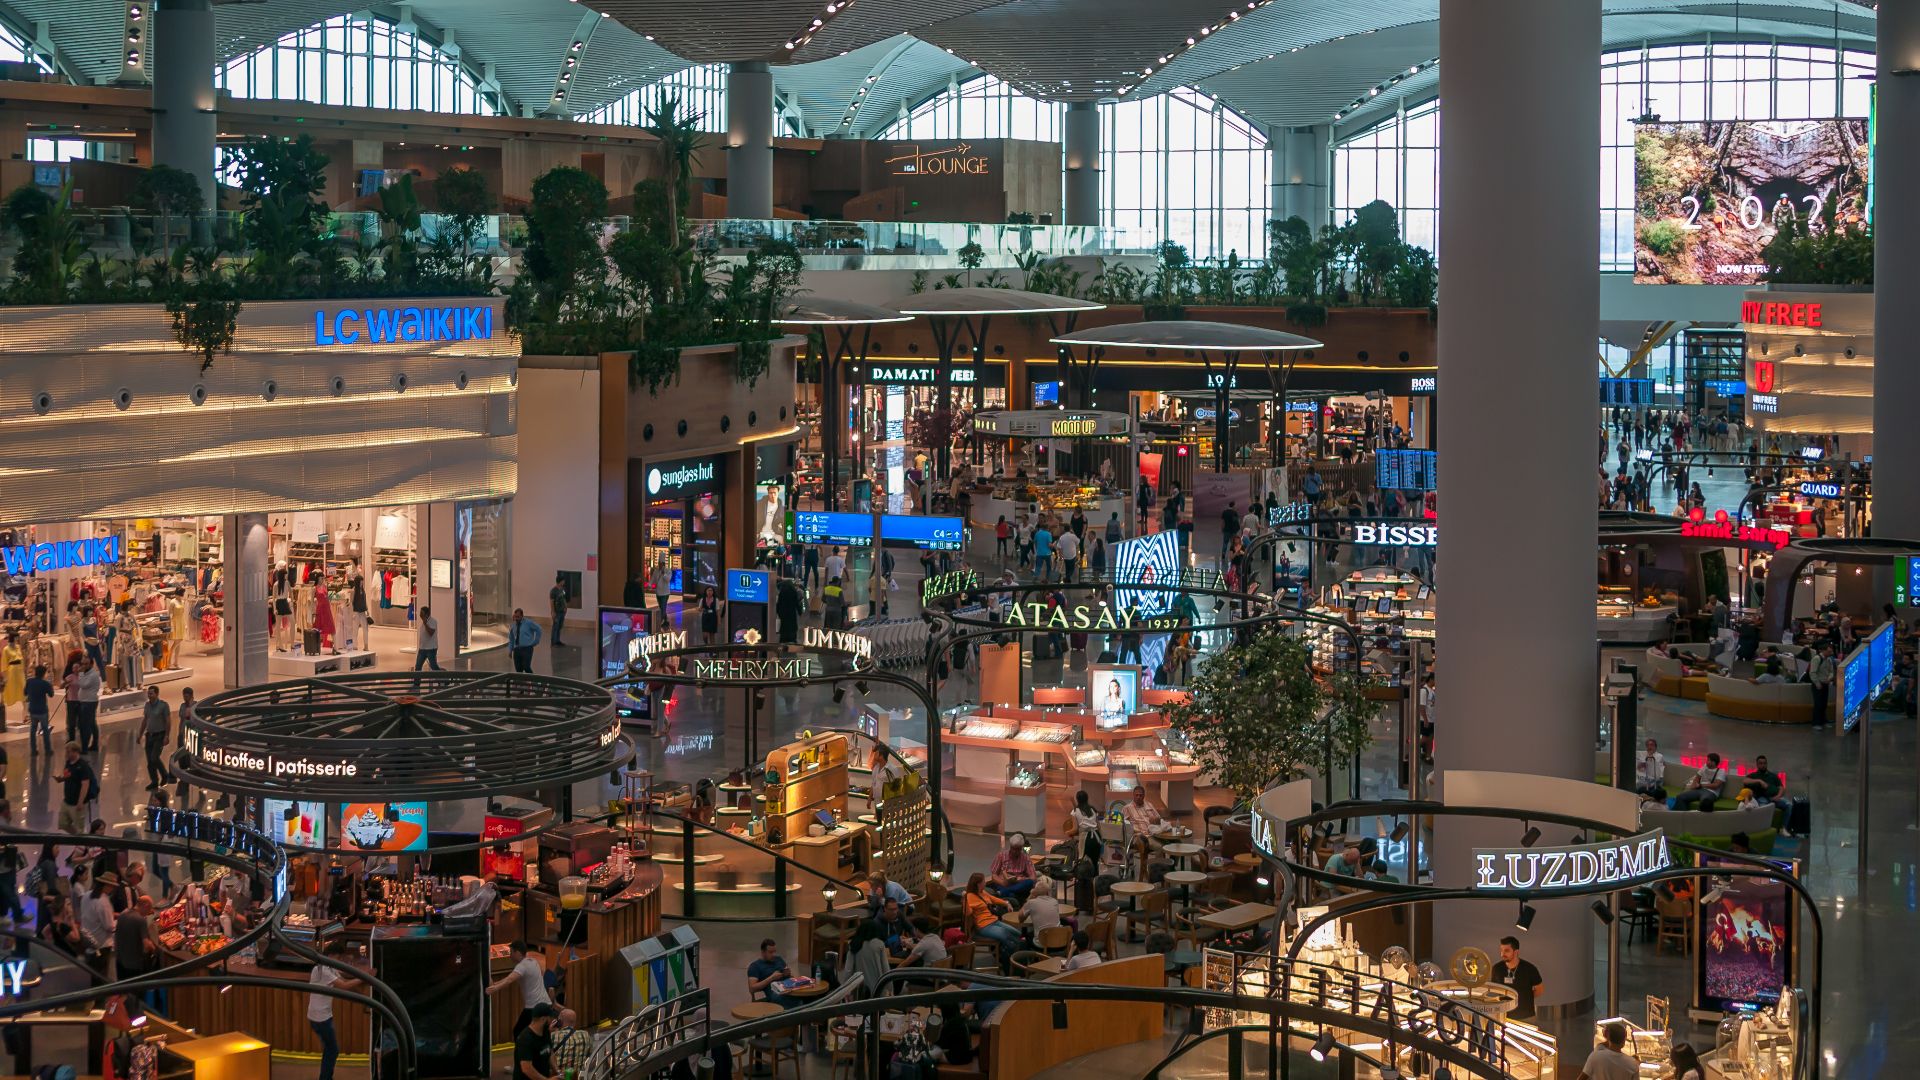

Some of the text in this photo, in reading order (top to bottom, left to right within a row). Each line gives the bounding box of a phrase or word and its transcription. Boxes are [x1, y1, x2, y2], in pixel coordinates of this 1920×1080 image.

[920, 157, 989, 174] LOUNGE
[1716, 264, 1742, 273] NOW
[1766, 302, 1822, 326] FREE
[315, 309, 360, 345] LC
[872, 368, 929, 381] DAMAT
[1052, 420, 1096, 435] MOOD UP
[662, 462, 713, 489] sunglass hut
[1801, 482, 1838, 496] GUARD
[933, 529, 945, 538] C4
[1006, 601, 1180, 630] ATASAY 1937
[694, 659, 811, 679] MEHRY MU
[601, 731, 612, 747] tea
[203, 746, 218, 763] tea
[224, 752, 265, 770] coffee
[276, 757, 357, 777] patisserie
[1476, 835, 1671, 888] LUZDEMIA
